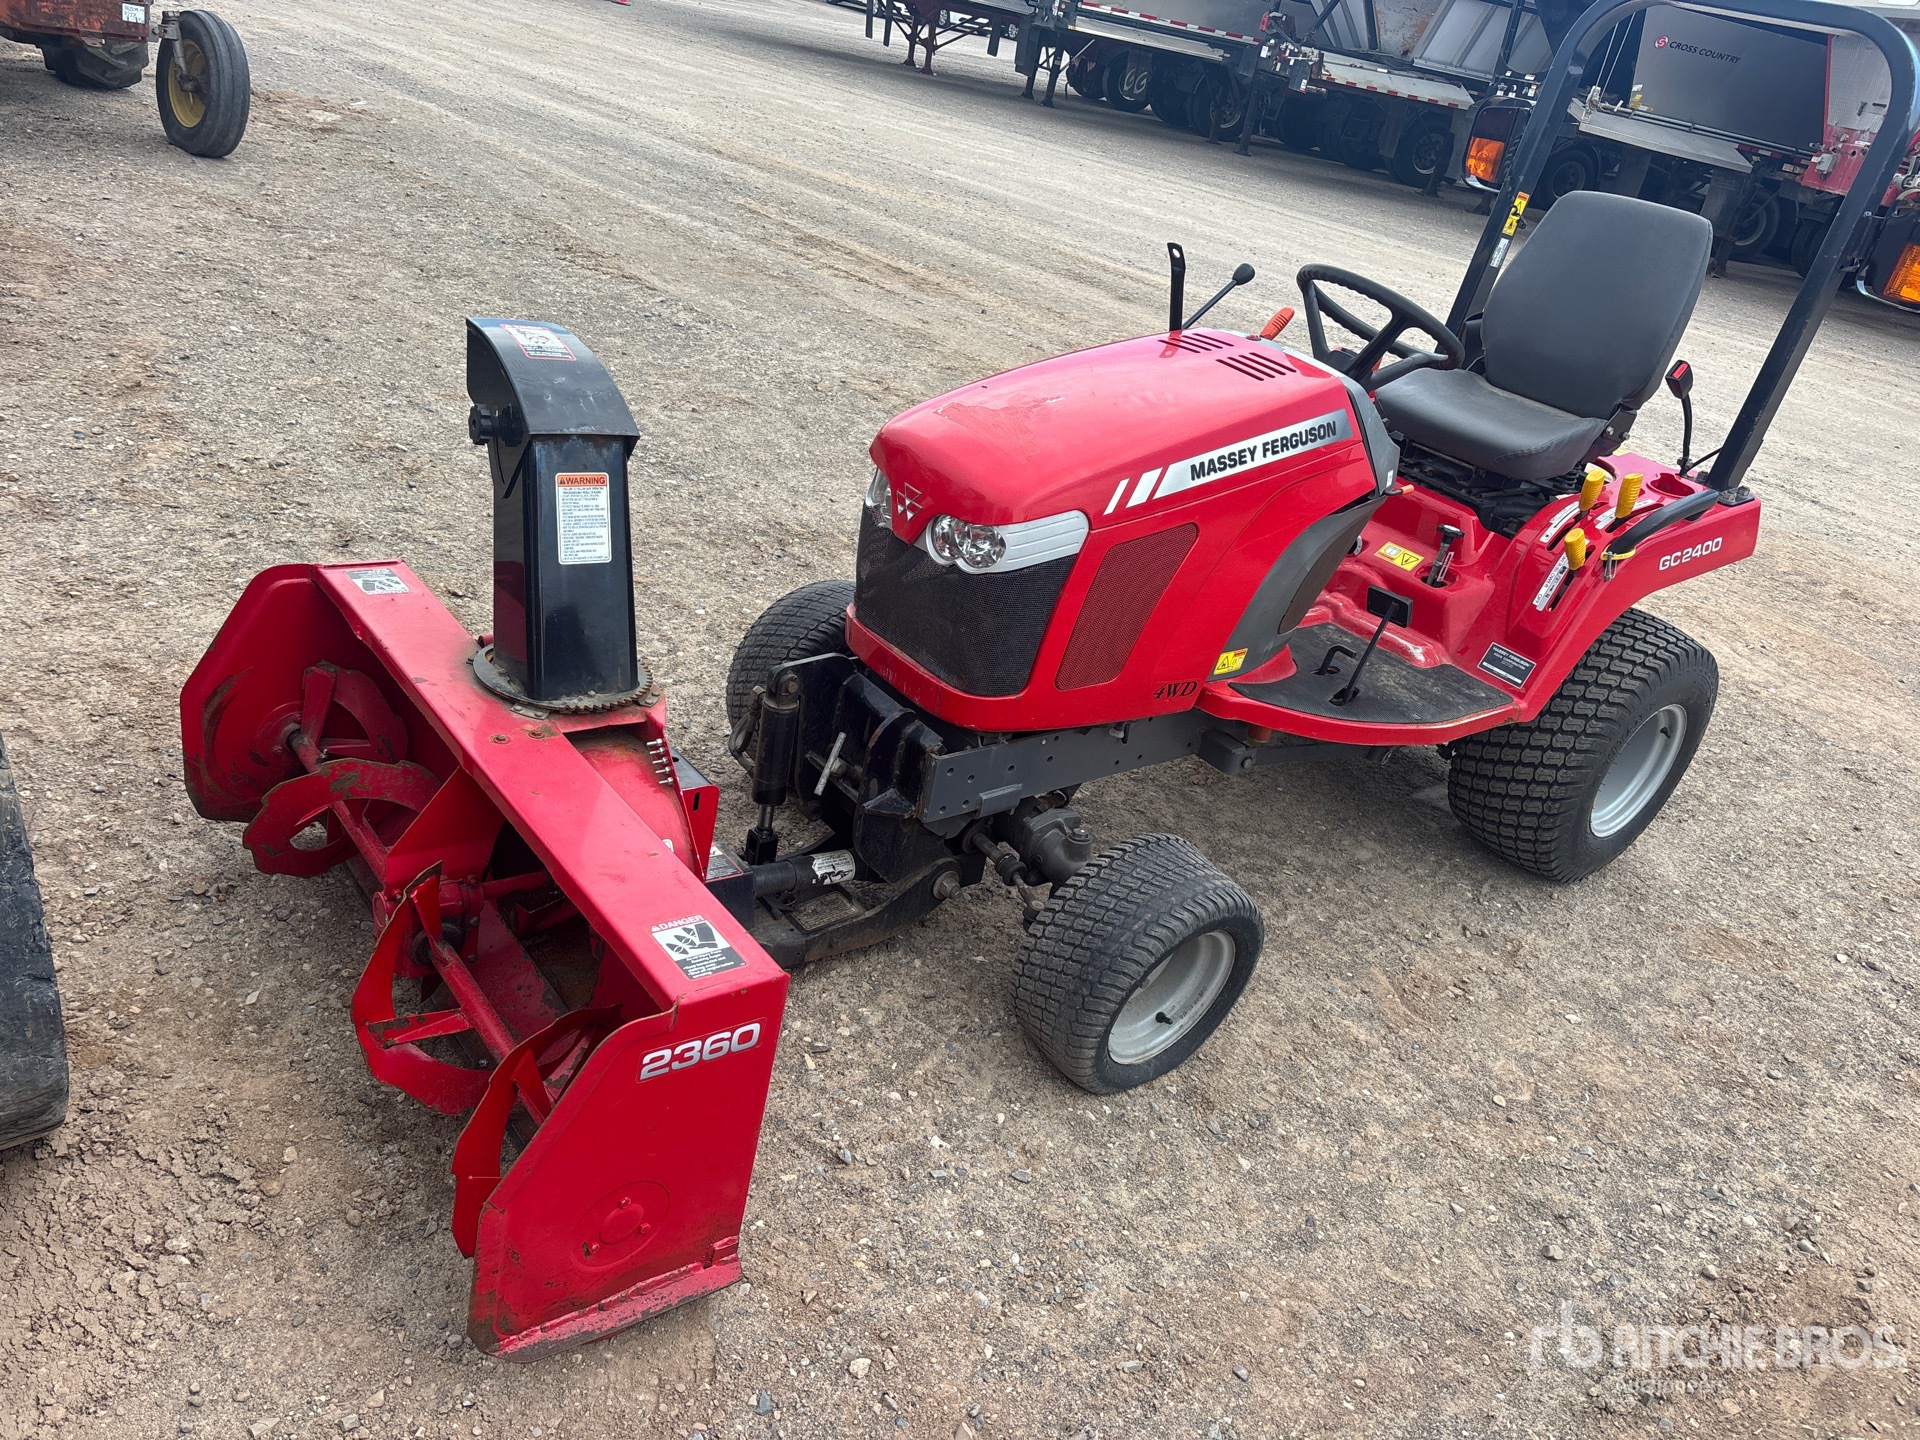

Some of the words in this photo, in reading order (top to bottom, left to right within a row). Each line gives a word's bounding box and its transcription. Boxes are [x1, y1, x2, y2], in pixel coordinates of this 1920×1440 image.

[1669, 41, 1699, 54] CROSS
[1698, 47, 1742, 64] COUNTRY
[1189, 445, 1258, 481] MASSEY
[1261, 420, 1337, 459] FERGUSON
[565, 476, 606, 485] WARNING
[1658, 536, 1723, 571] GC2400
[1152, 681, 1198, 700] 4WD
[658, 914, 705, 930] DANGER
[640, 1022, 761, 1081] 2360
